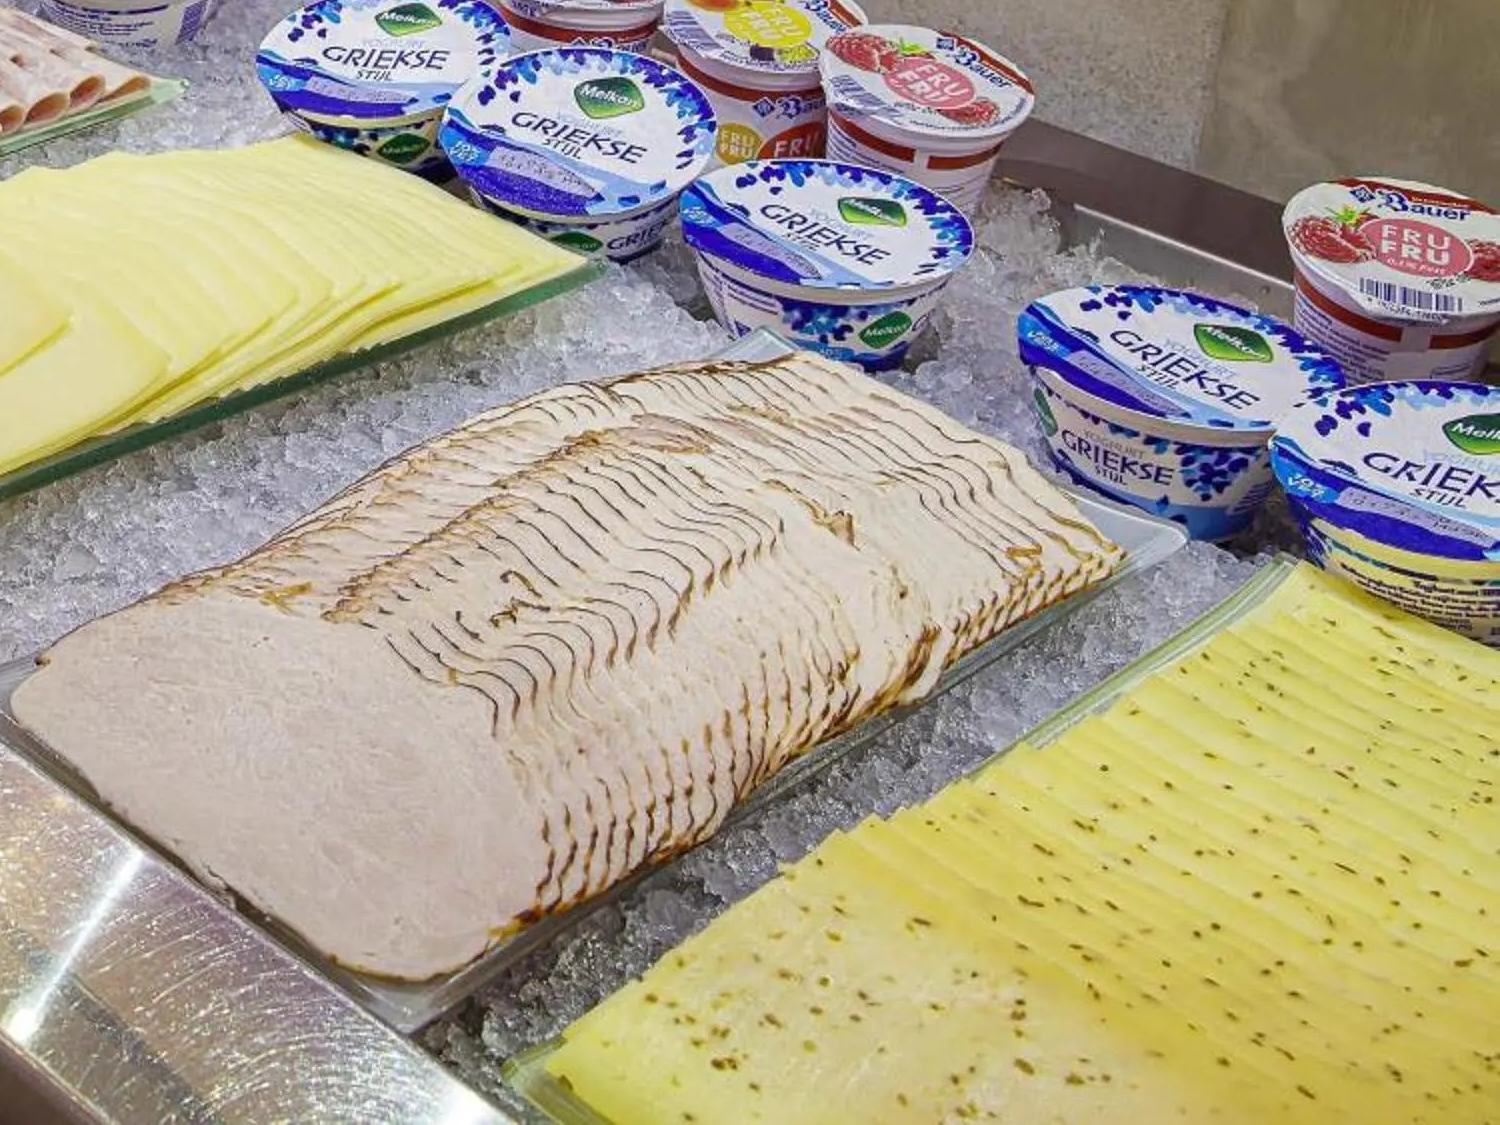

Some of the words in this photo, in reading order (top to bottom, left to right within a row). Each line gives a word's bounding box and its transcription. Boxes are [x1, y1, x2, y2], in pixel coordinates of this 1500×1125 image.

[322, 45, 451, 71] GRIEKSE
[949, 45, 1013, 88] Bauer
[355, 69, 394, 82] STIJL
[896, 70, 952, 102] FRU
[915, 64, 972, 97] FRU
[579, 82, 639, 107] Melkan
[510, 111, 648, 165] GRIEKSE
[541, 137, 583, 161] STIJL
[721, 130, 756, 148] FRU
[1376, 189, 1470, 221] Bauer
[759, 204, 891, 266] GRIEKSE
[1382, 224, 1451, 251] FRU
[1381, 238, 1450, 266] FRU
[1110, 331, 1260, 410] GRIEKSE
[1137, 365, 1177, 390] STIJL
[1061, 429, 1175, 486] GRIEKSE
[1094, 465, 1128, 486] STIJL
[1363, 453, 1500, 504] GRIEK
[1409, 487, 1468, 508] STIJL
